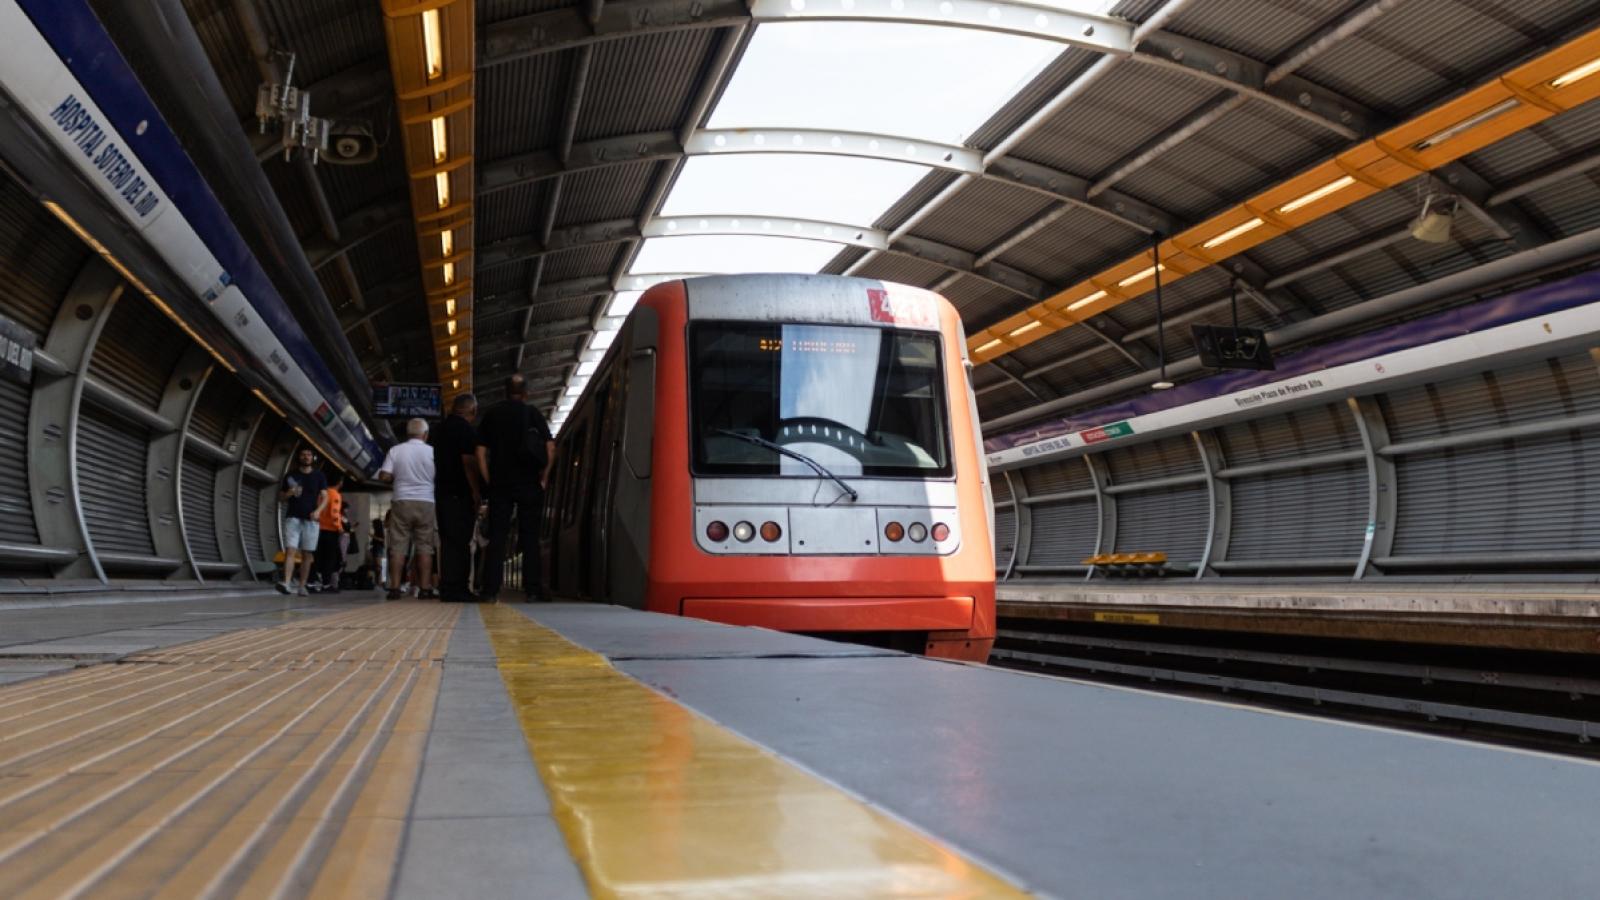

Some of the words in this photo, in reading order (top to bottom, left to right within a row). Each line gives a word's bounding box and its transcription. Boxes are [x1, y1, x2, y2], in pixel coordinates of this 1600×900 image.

[49, 94, 107, 158] HOSPITAL
[93, 143, 136, 190] SOTERO
[121, 175, 148, 205] DEL
